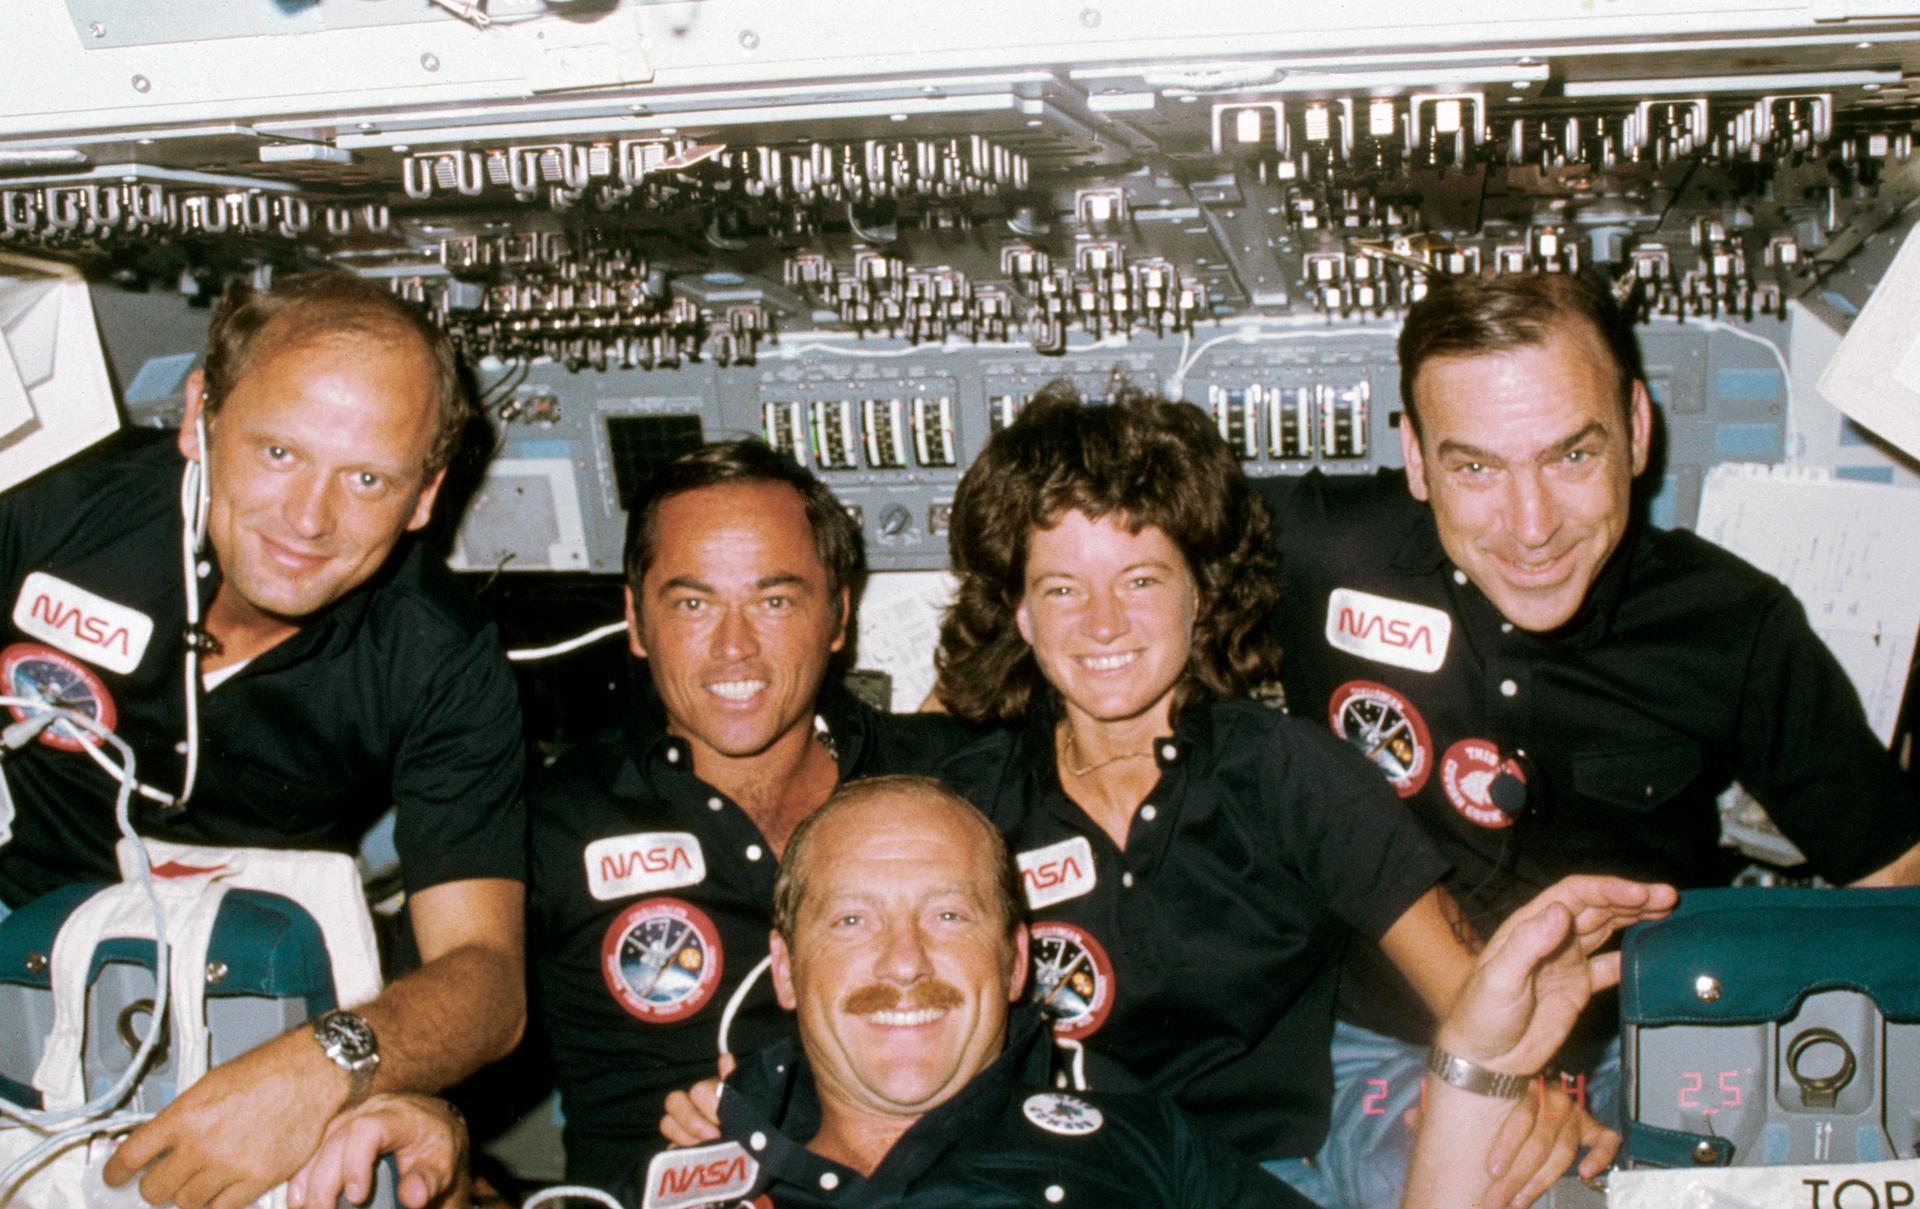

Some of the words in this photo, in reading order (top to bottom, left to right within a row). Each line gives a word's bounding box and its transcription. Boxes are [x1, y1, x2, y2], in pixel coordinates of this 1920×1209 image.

[32, 594, 129, 656] NASA
[1339, 607, 1432, 655] NASA
[601, 847, 693, 881] NASA
[1021, 856, 1083, 891] ASA
[658, 1153, 747, 1197] NASA
[1802, 1179, 1914, 1209] TOP
